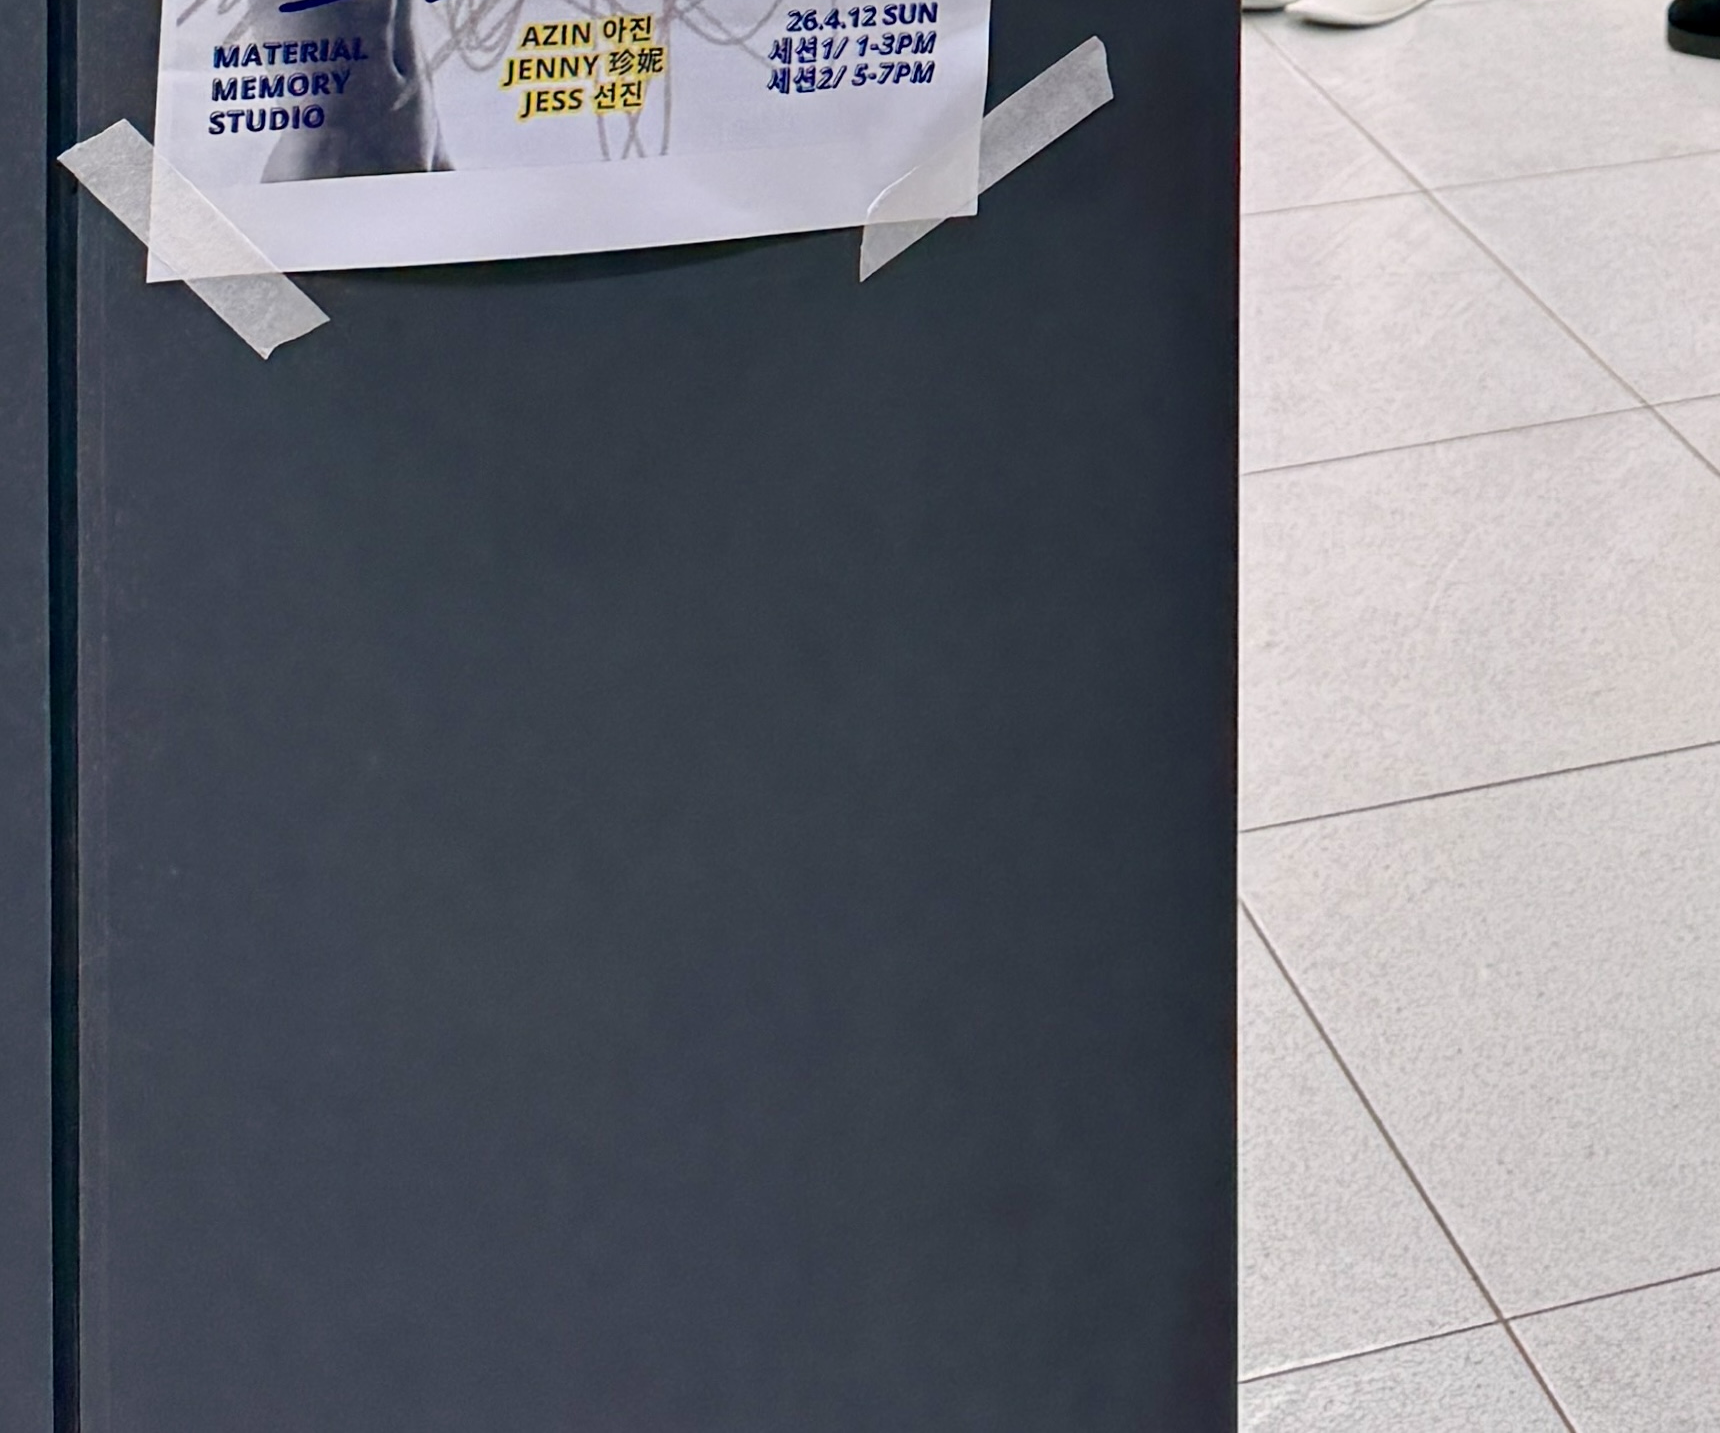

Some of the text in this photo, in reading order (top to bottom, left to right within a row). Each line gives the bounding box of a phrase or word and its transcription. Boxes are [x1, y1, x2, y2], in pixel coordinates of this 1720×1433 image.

[521, 16, 651, 47] AZIN 아진
[786, 2, 938, 32] 26.4.12 SUN
[213, 37, 369, 69] MATERIAL
[856, 31, 937, 57] 1-3PM
[503, 47, 664, 86] JENNY 珍妮
[851, 60, 936, 86] 5-7PM
[211, 69, 351, 101] MEMORY
[520, 80, 642, 119] JESS 선진
[208, 104, 325, 135] STUDIO
